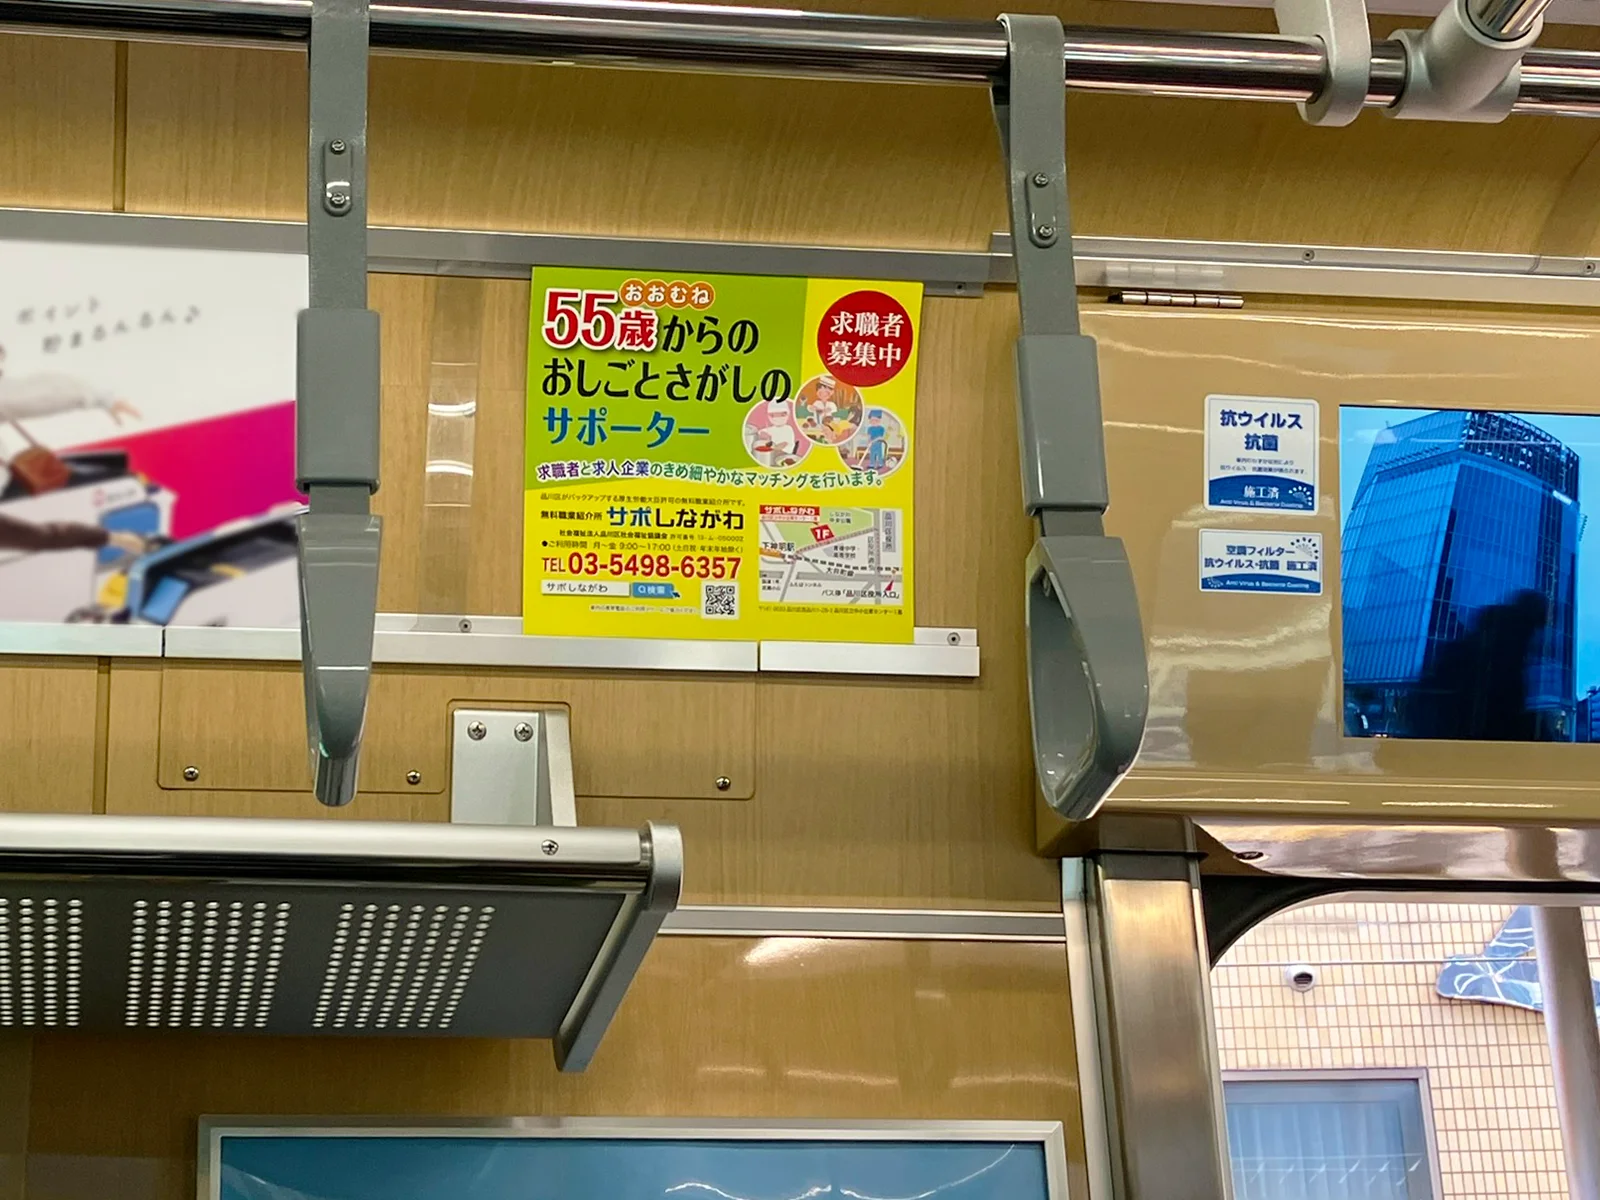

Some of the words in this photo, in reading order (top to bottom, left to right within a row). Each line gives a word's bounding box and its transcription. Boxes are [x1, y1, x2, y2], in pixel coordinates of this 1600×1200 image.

[625, 284, 711, 304] おおむね
[543, 287, 760, 354] 55歳からの
[829, 312, 905, 338] 求職者
[826, 340, 903, 368] 募集中
[542, 357, 792, 403] おしごとさがしの
[542, 406, 710, 448] サポーター
[1220, 408, 1303, 429] 抗ウイルス
[1244, 433, 1279, 452] 抗菌
[537, 461, 882, 489] 求職者と求人企業のきめ細やかなマッチングを行います。
[1243, 485, 1280, 500] 施工済
[540, 511, 602, 522] 無料職業紹介所
[606, 507, 744, 530] サポしながわ
[814, 528, 832, 540] 1F
[1225, 545, 1296, 557] 空調フィルター
[542, 558, 566, 573] TEL
[568, 551, 742, 580] 03-5498-6357
[1204, 558, 1280, 570] 抗ウイルス・抗菌
[547, 582, 609, 593] サポしながわ
